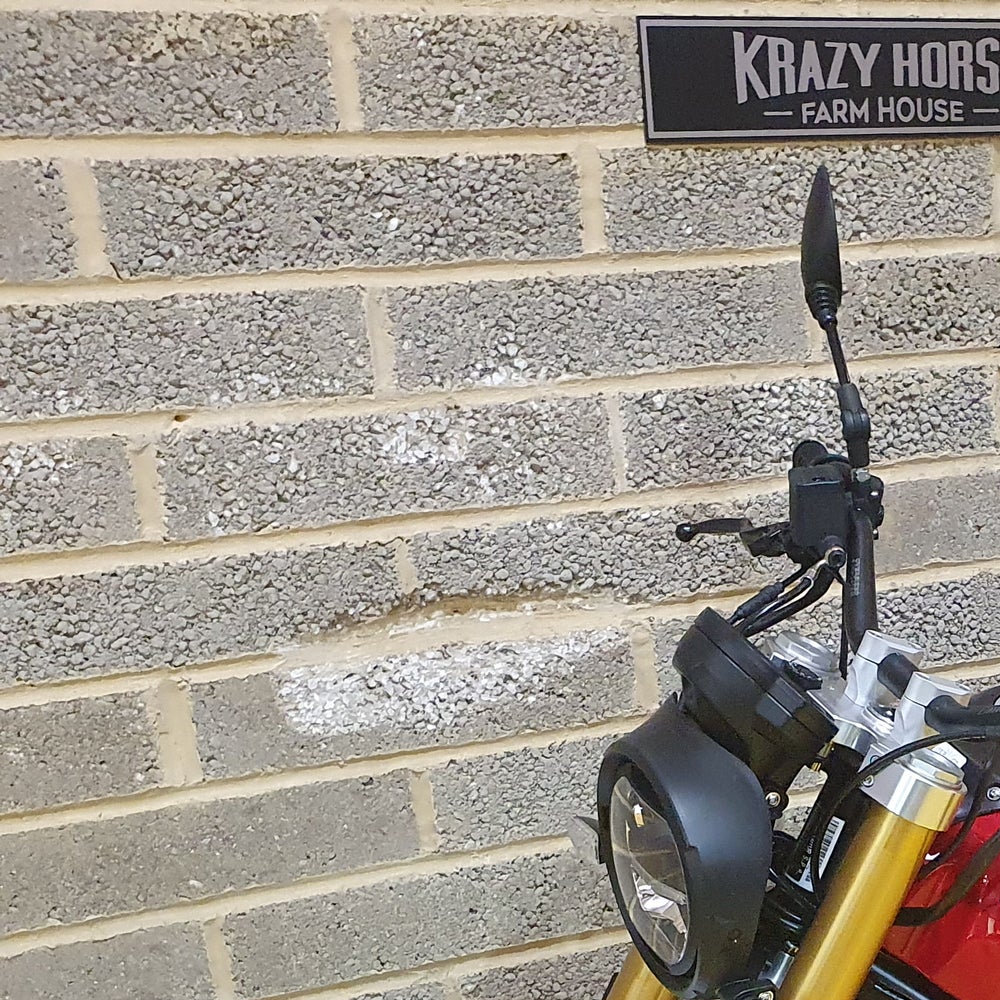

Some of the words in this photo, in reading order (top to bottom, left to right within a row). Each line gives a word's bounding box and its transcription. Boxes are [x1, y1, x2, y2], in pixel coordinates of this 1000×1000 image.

[732, 30, 882, 104] KRAZY
[801, 97, 870, 124] FARM
[877, 96, 965, 123] HOUSE
